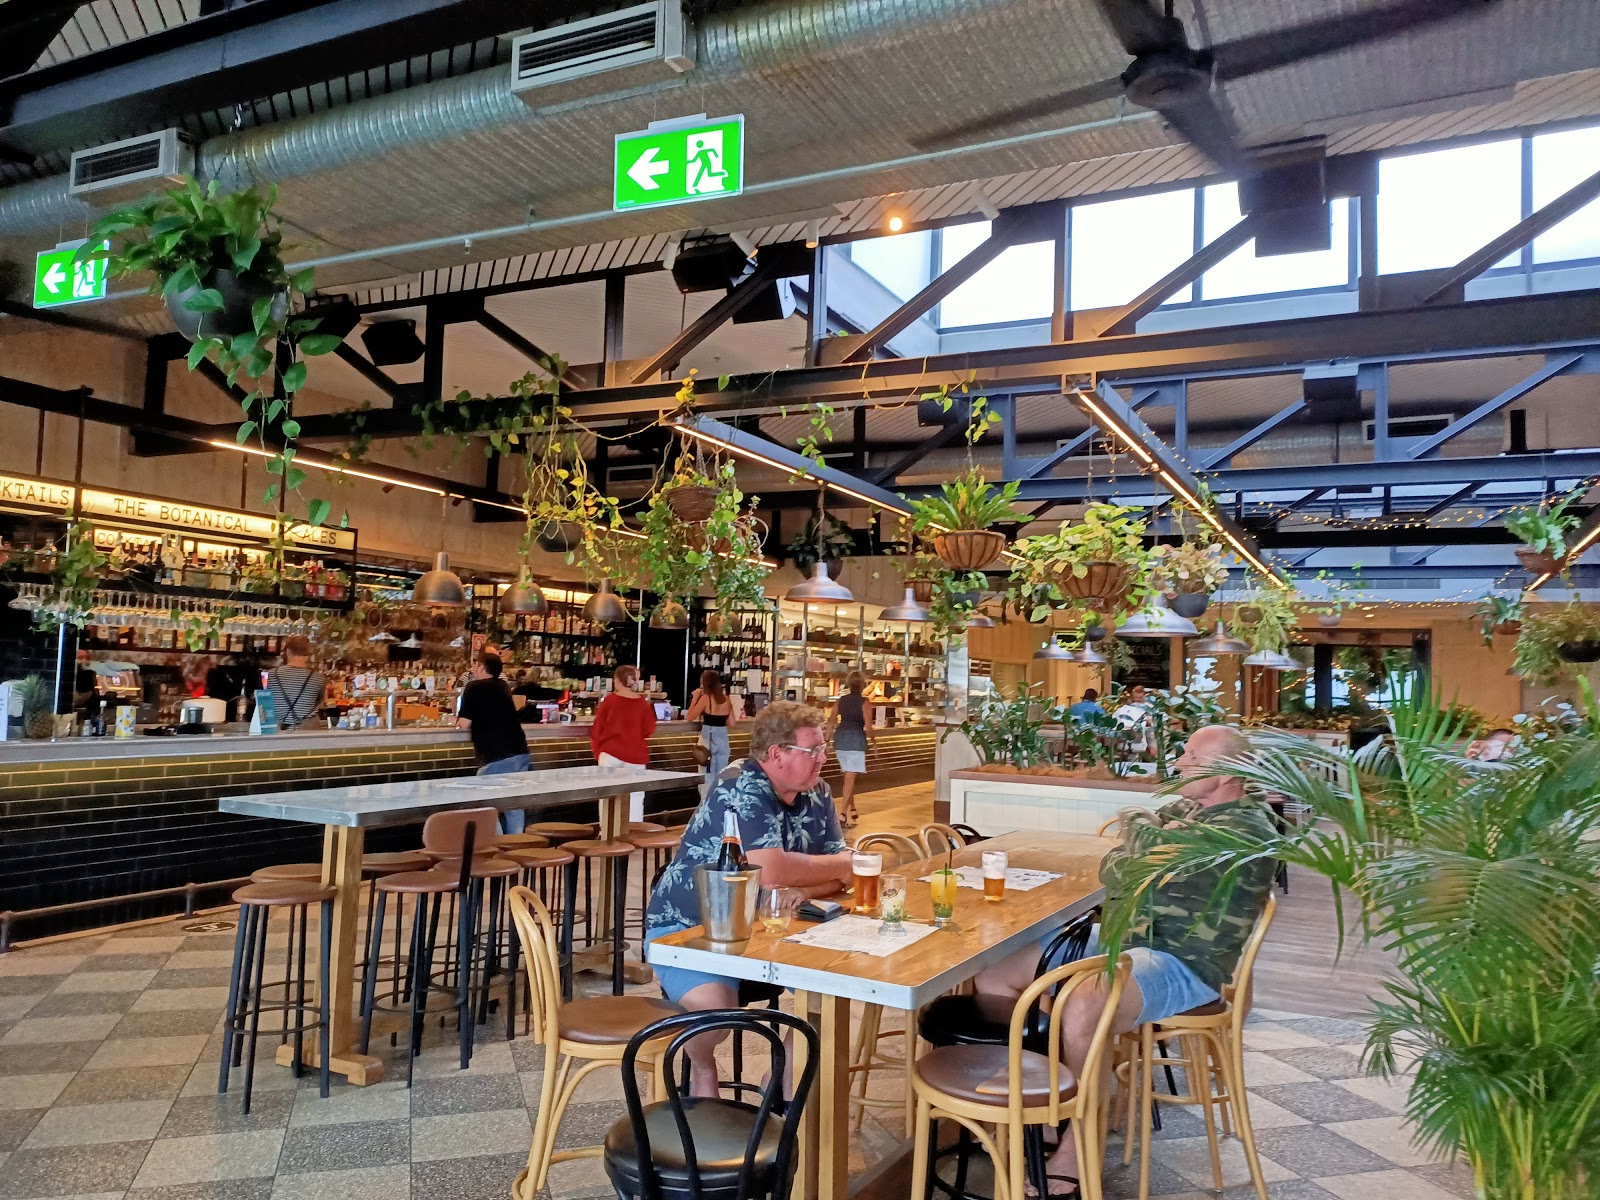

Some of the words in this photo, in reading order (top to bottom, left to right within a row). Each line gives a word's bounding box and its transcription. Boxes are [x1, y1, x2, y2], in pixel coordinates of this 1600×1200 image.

[0, 480, 69, 506] KTAILS
[113, 497, 147, 517] THE
[159, 505, 252, 533] BOTANICAL
